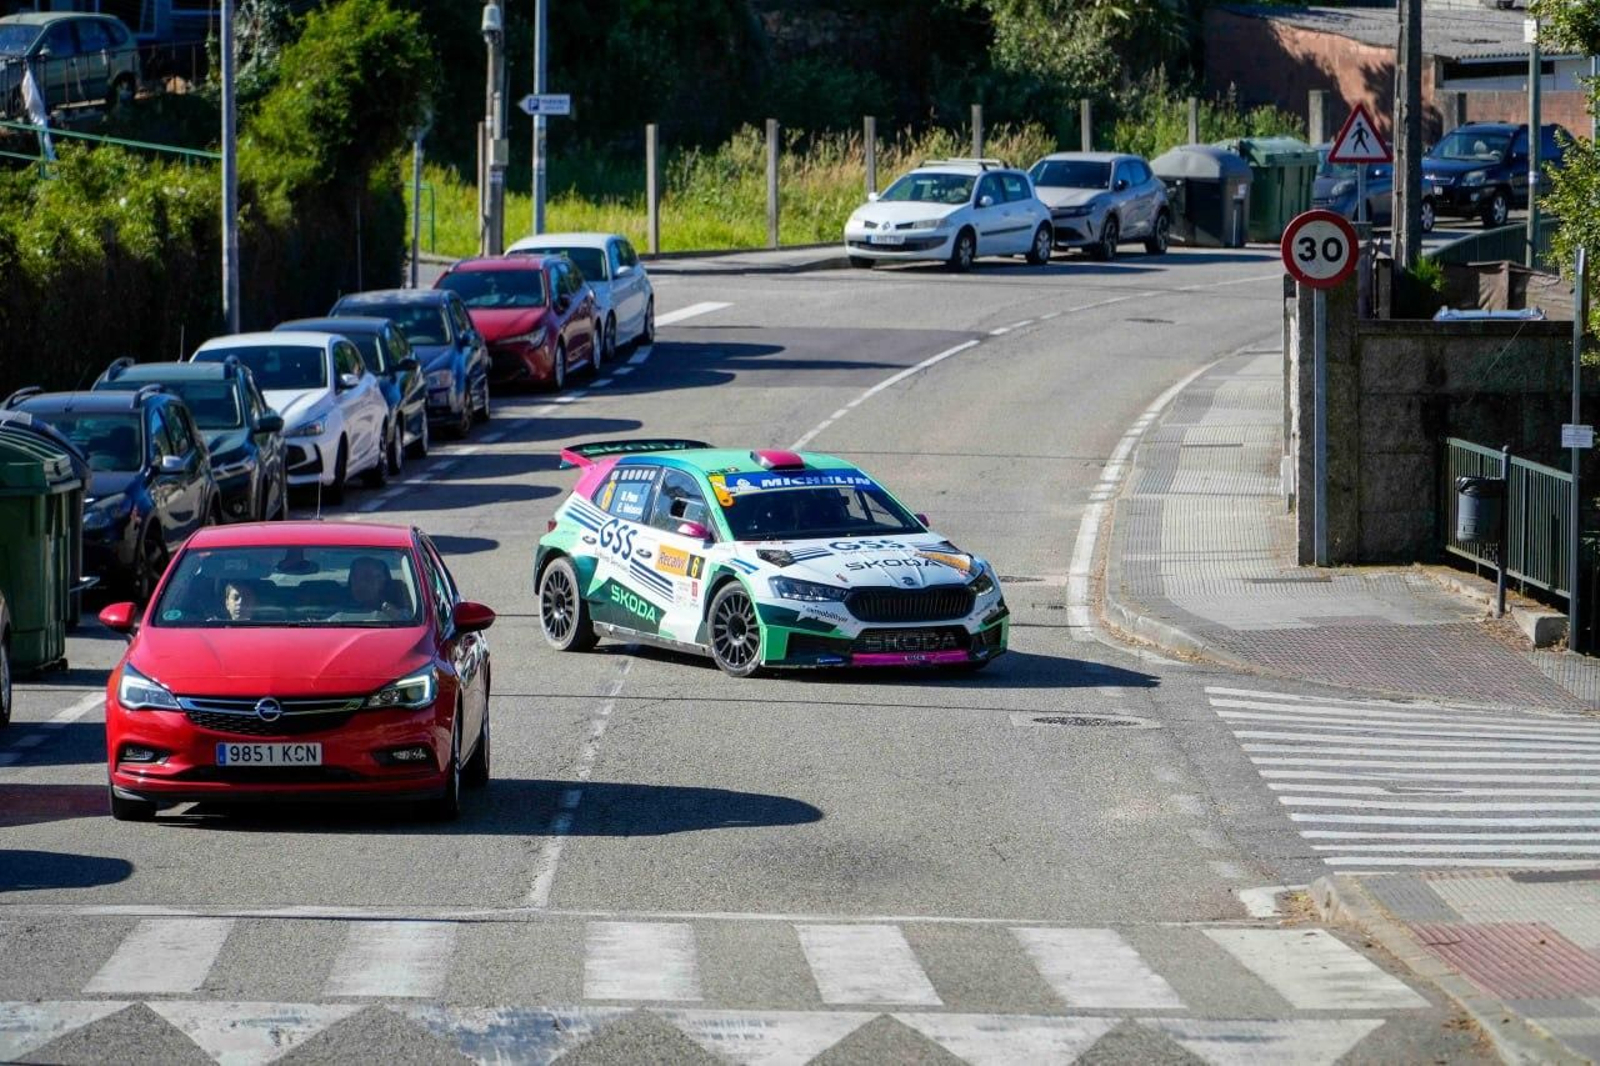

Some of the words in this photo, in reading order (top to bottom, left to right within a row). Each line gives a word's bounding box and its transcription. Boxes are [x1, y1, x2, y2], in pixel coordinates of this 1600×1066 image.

[1298, 237, 1342, 262] 30
[761, 476, 871, 488] MICHELIN
[600, 519, 637, 560] GSS
[829, 540, 906, 551] GSS
[691, 556, 700, 578] 6
[229, 745, 273, 762] 9851
[282, 745, 317, 762] KCN
